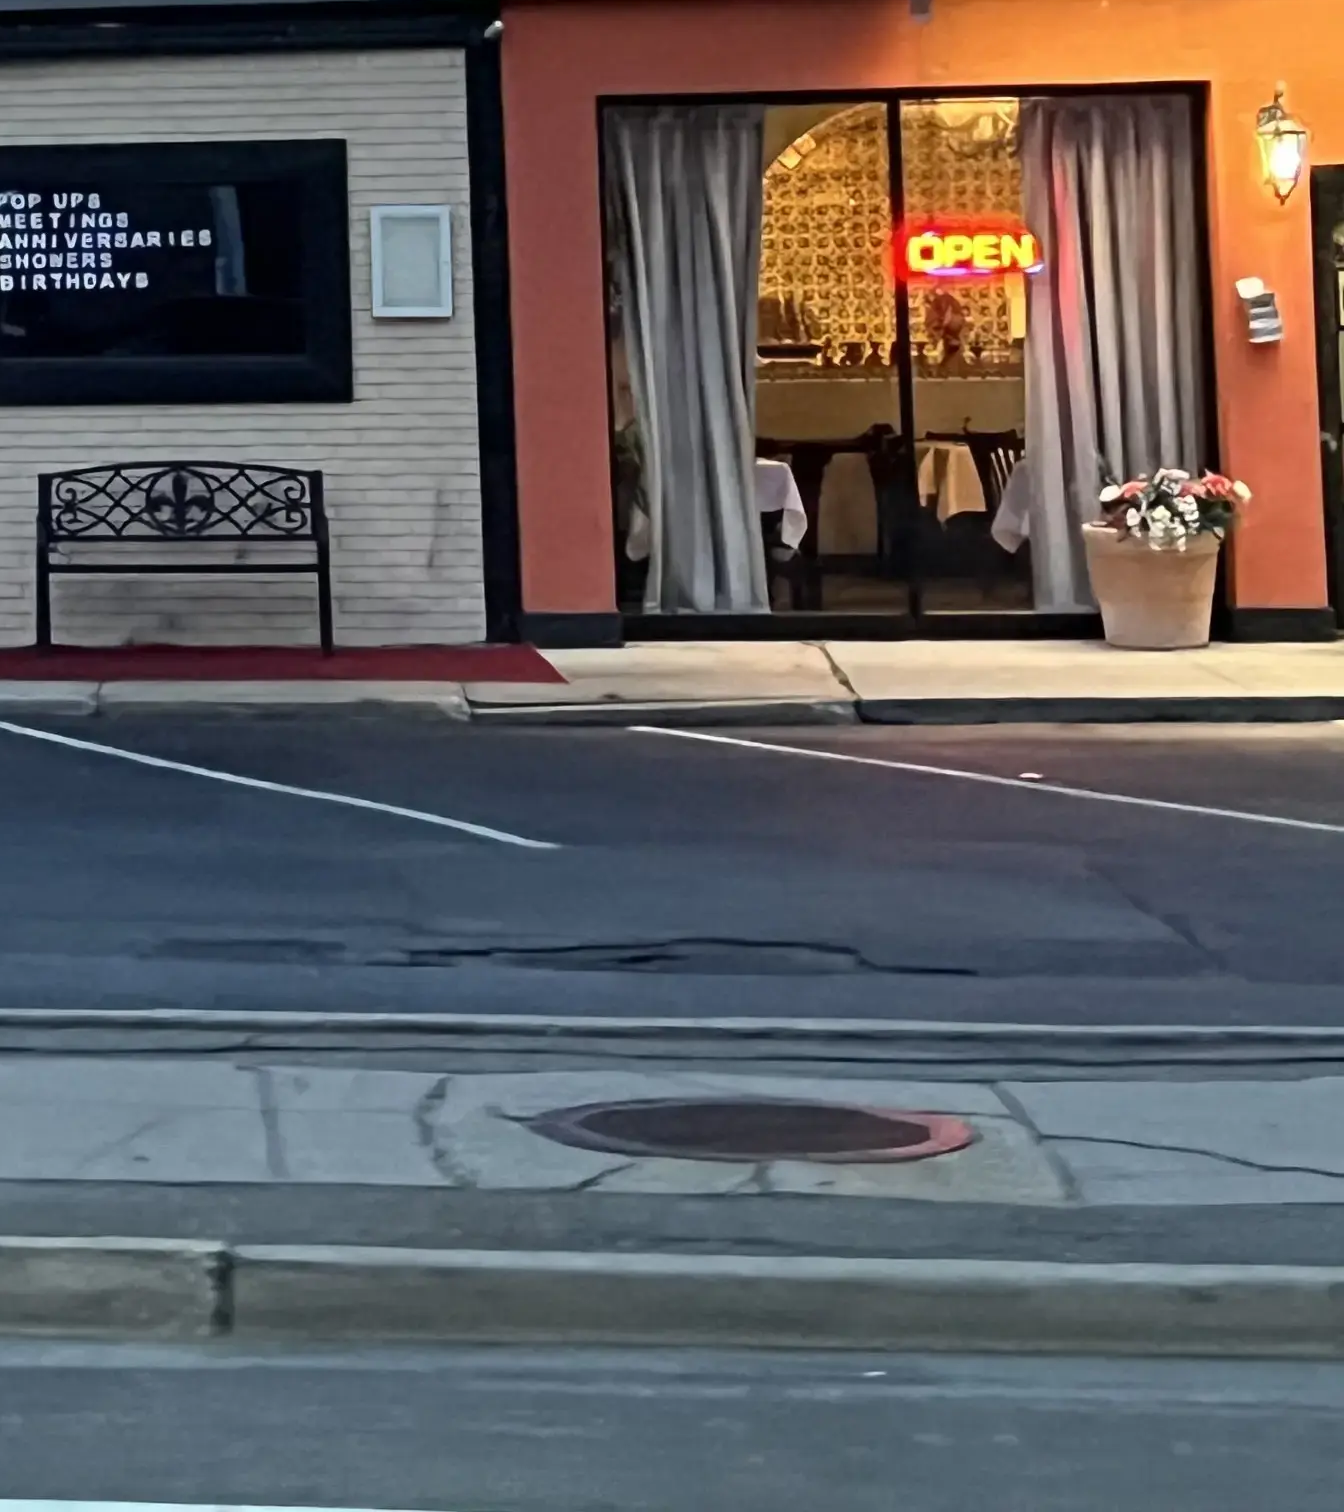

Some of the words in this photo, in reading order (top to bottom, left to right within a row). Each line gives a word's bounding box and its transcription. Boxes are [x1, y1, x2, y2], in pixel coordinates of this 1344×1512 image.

[0, 252, 113, 270] SHOWERS
[907, 233, 1035, 272] OPEN
[0, 271, 149, 291] BIRTHDAYS
